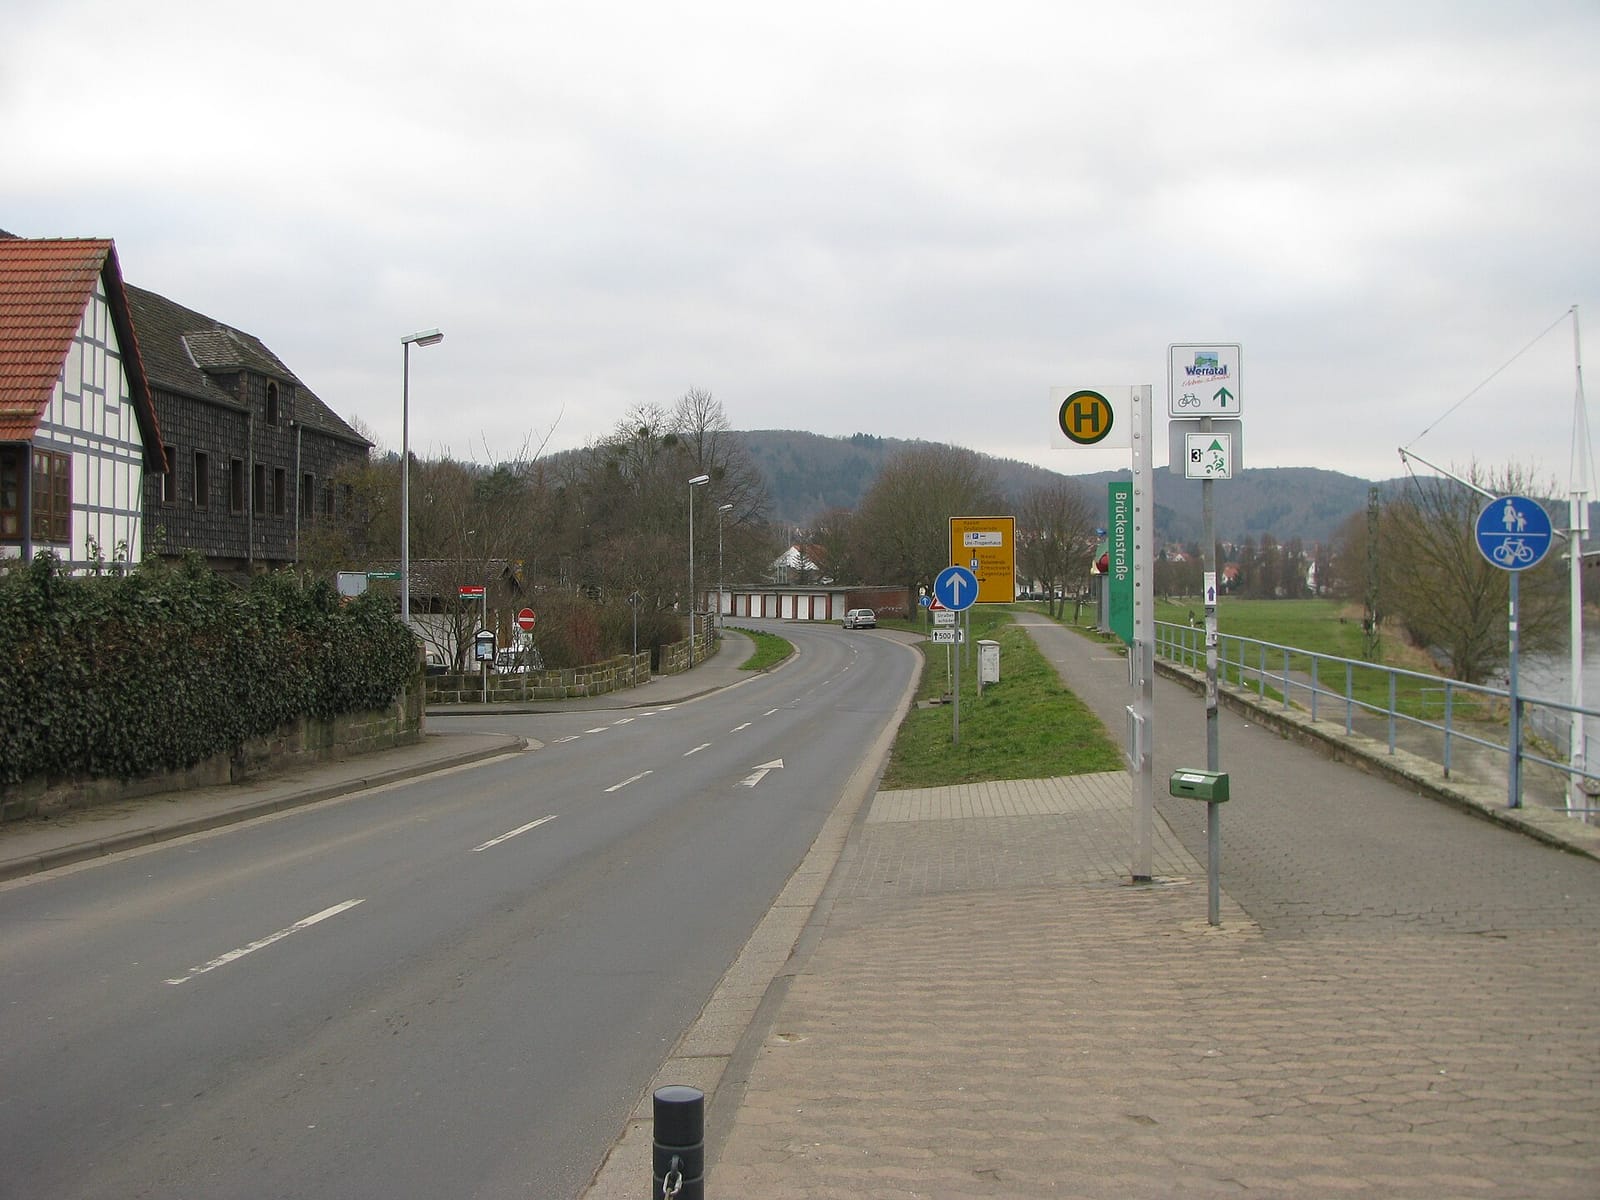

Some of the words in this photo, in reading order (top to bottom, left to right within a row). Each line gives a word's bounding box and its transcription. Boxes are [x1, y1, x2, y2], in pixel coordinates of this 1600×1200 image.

[1185, 364, 1228, 376] Werratal
[1073, 402, 1099, 433] H
[1115, 492, 1129, 581] Brückenstraße
